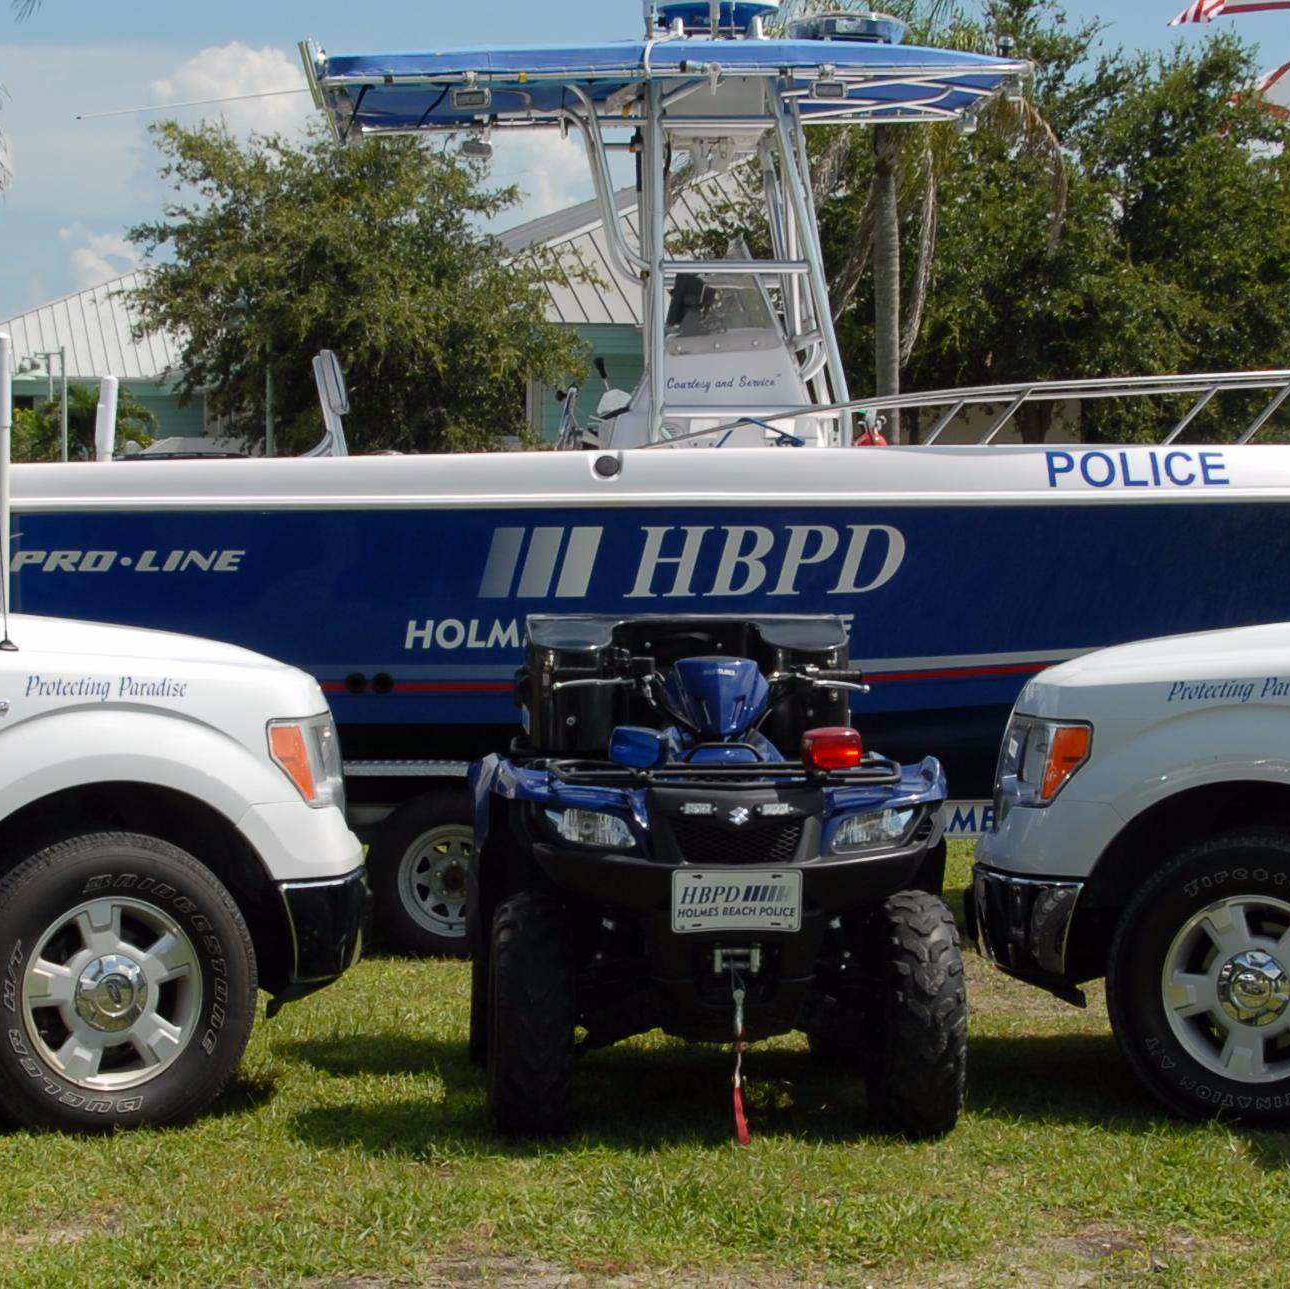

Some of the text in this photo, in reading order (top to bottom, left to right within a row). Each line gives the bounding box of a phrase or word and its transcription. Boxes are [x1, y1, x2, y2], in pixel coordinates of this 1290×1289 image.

[667, 377, 711, 393] Courtesy
[715, 377, 735, 388] and
[1045, 451, 1230, 487] POLICE
[622, 524, 906, 598] HBPD
[404, 618, 528, 650] HOLM
[25, 675, 188, 702] Protecting Paradise
[1167, 681, 1255, 703] Protecting
[943, 805, 994, 833] ME
[680, 885, 740, 905] HBPD
[677, 906, 796, 919] HOLMES BEACH POLICE
